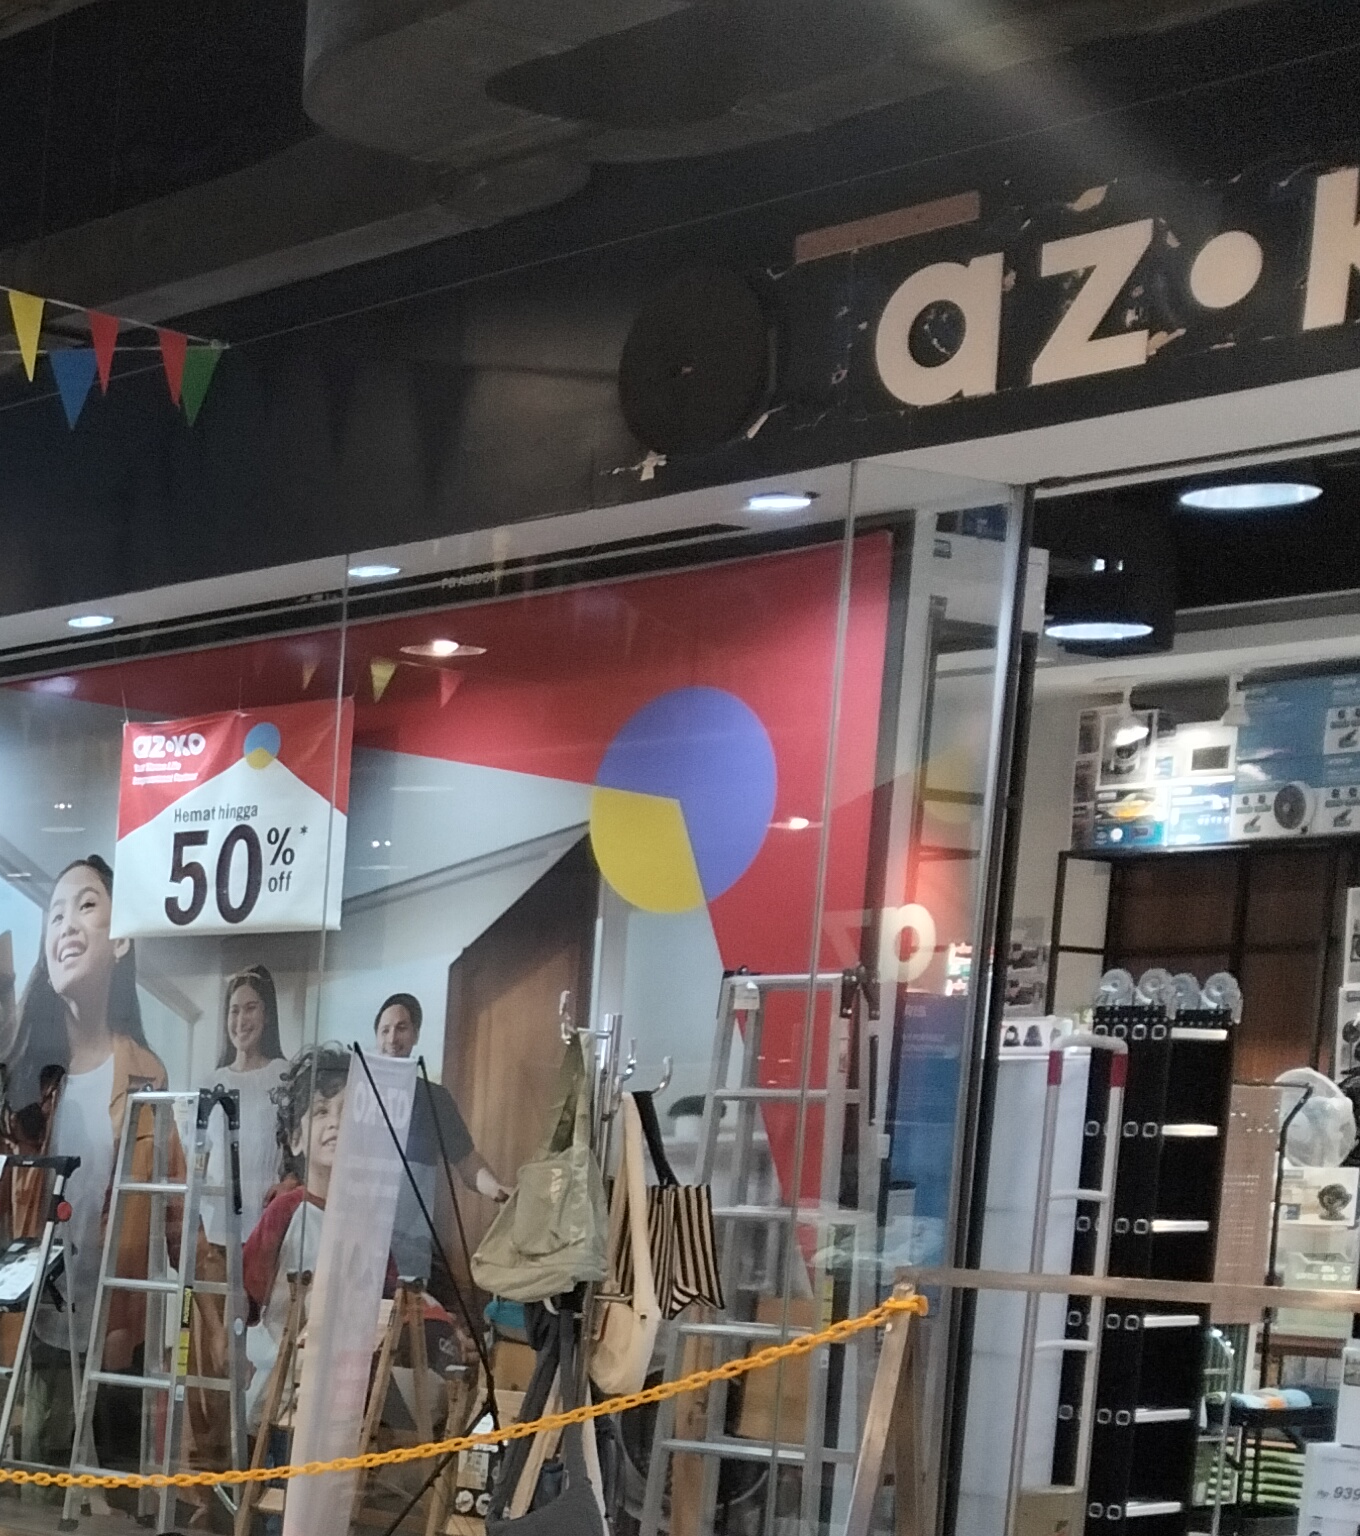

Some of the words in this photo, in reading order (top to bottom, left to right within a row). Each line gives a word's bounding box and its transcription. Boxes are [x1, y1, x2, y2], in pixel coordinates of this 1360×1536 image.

[174, 807, 216, 823] Hemat
[218, 803, 258, 821] hingga
[268, 871, 293, 892] off
